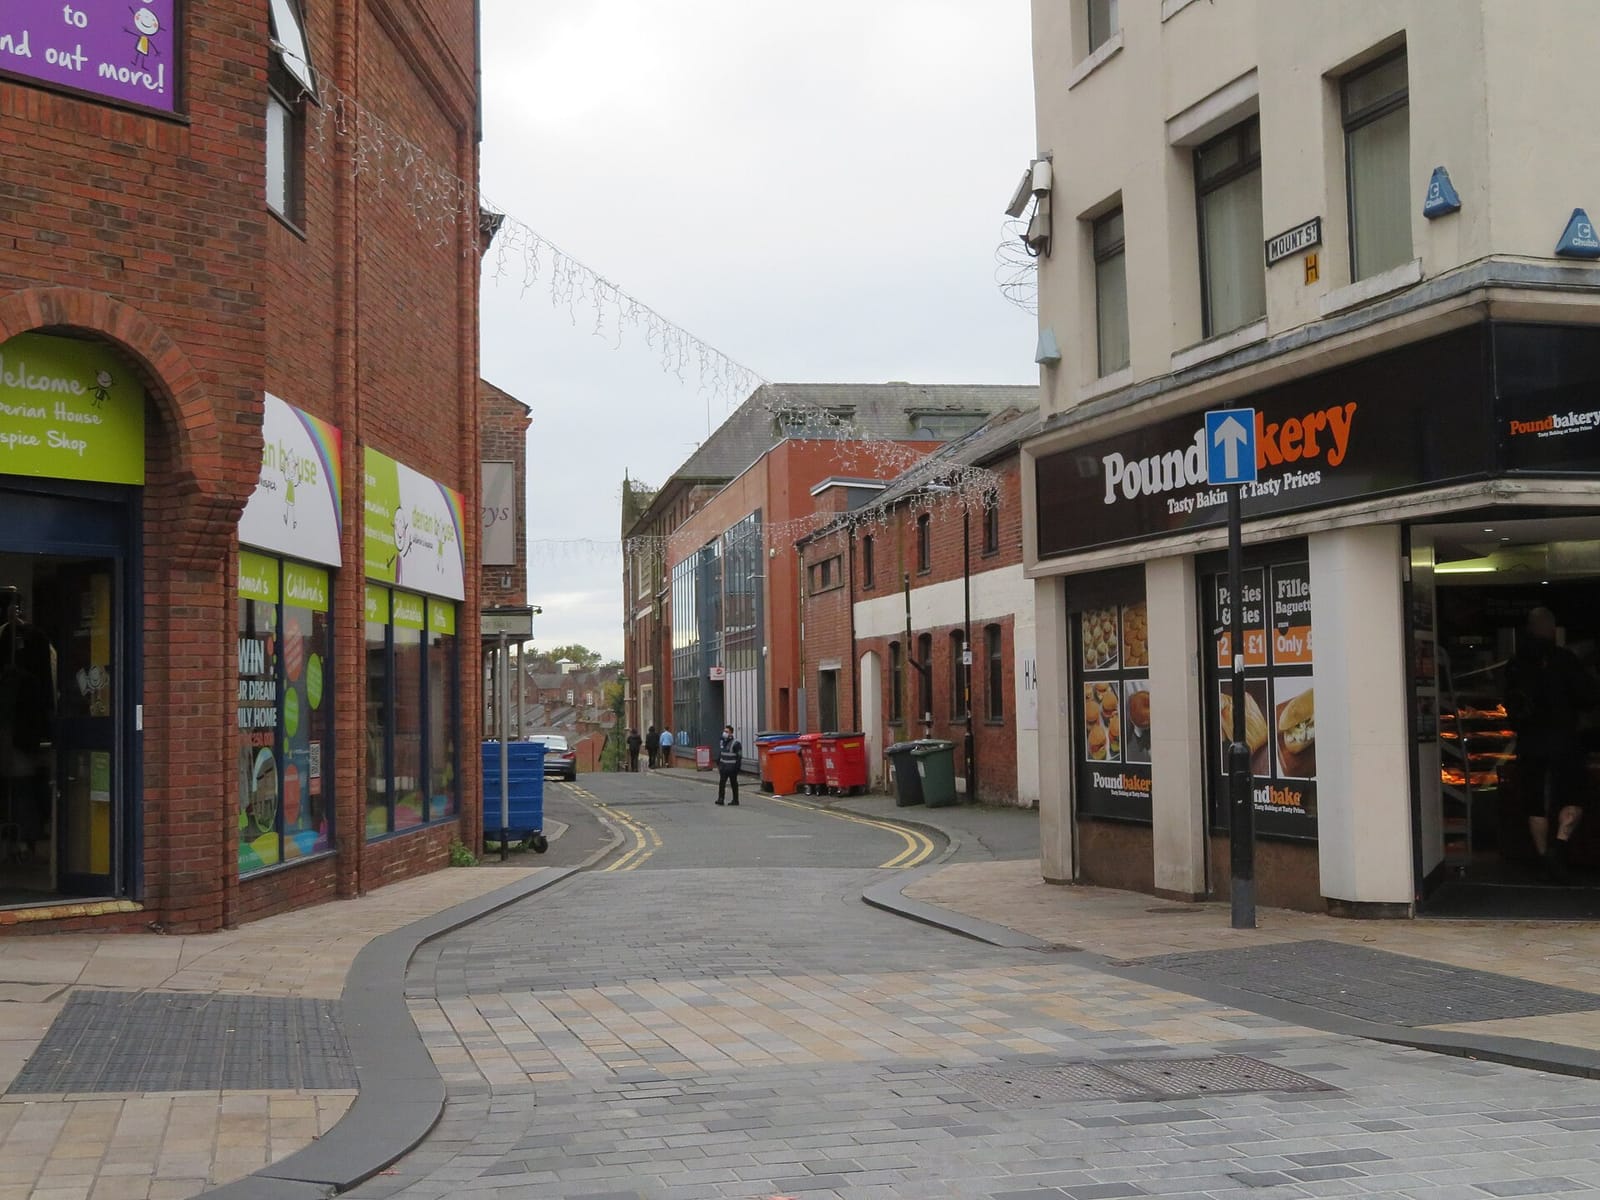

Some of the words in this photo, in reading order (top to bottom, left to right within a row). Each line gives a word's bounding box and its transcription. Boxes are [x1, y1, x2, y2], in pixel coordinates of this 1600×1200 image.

[63, 5, 88, 28] to
[45, 44, 88, 71] out
[99, 62, 164, 93] more!
[1271, 228, 1304, 259] MOUNT
[0, 353, 86, 395] elcome
[54, 401, 102, 424] House
[46, 430, 87, 456] Shop
[1102, 402, 1357, 504] Poundkery
[1167, 498, 1194, 514] Tasty
[1196, 488, 1228, 508] Bakin
[1249, 478, 1281, 497] Tasty
[1283, 470, 1321, 490] Prices
[1277, 578, 1312, 599] Fille
[238, 639, 264, 674] WIN
[1221, 637, 1228, 656] 2
[1248, 634, 1263, 654] £1
[1277, 634, 1302, 656] Only
[249, 681, 276, 700] DREAM
[254, 707, 277, 728] HOME
